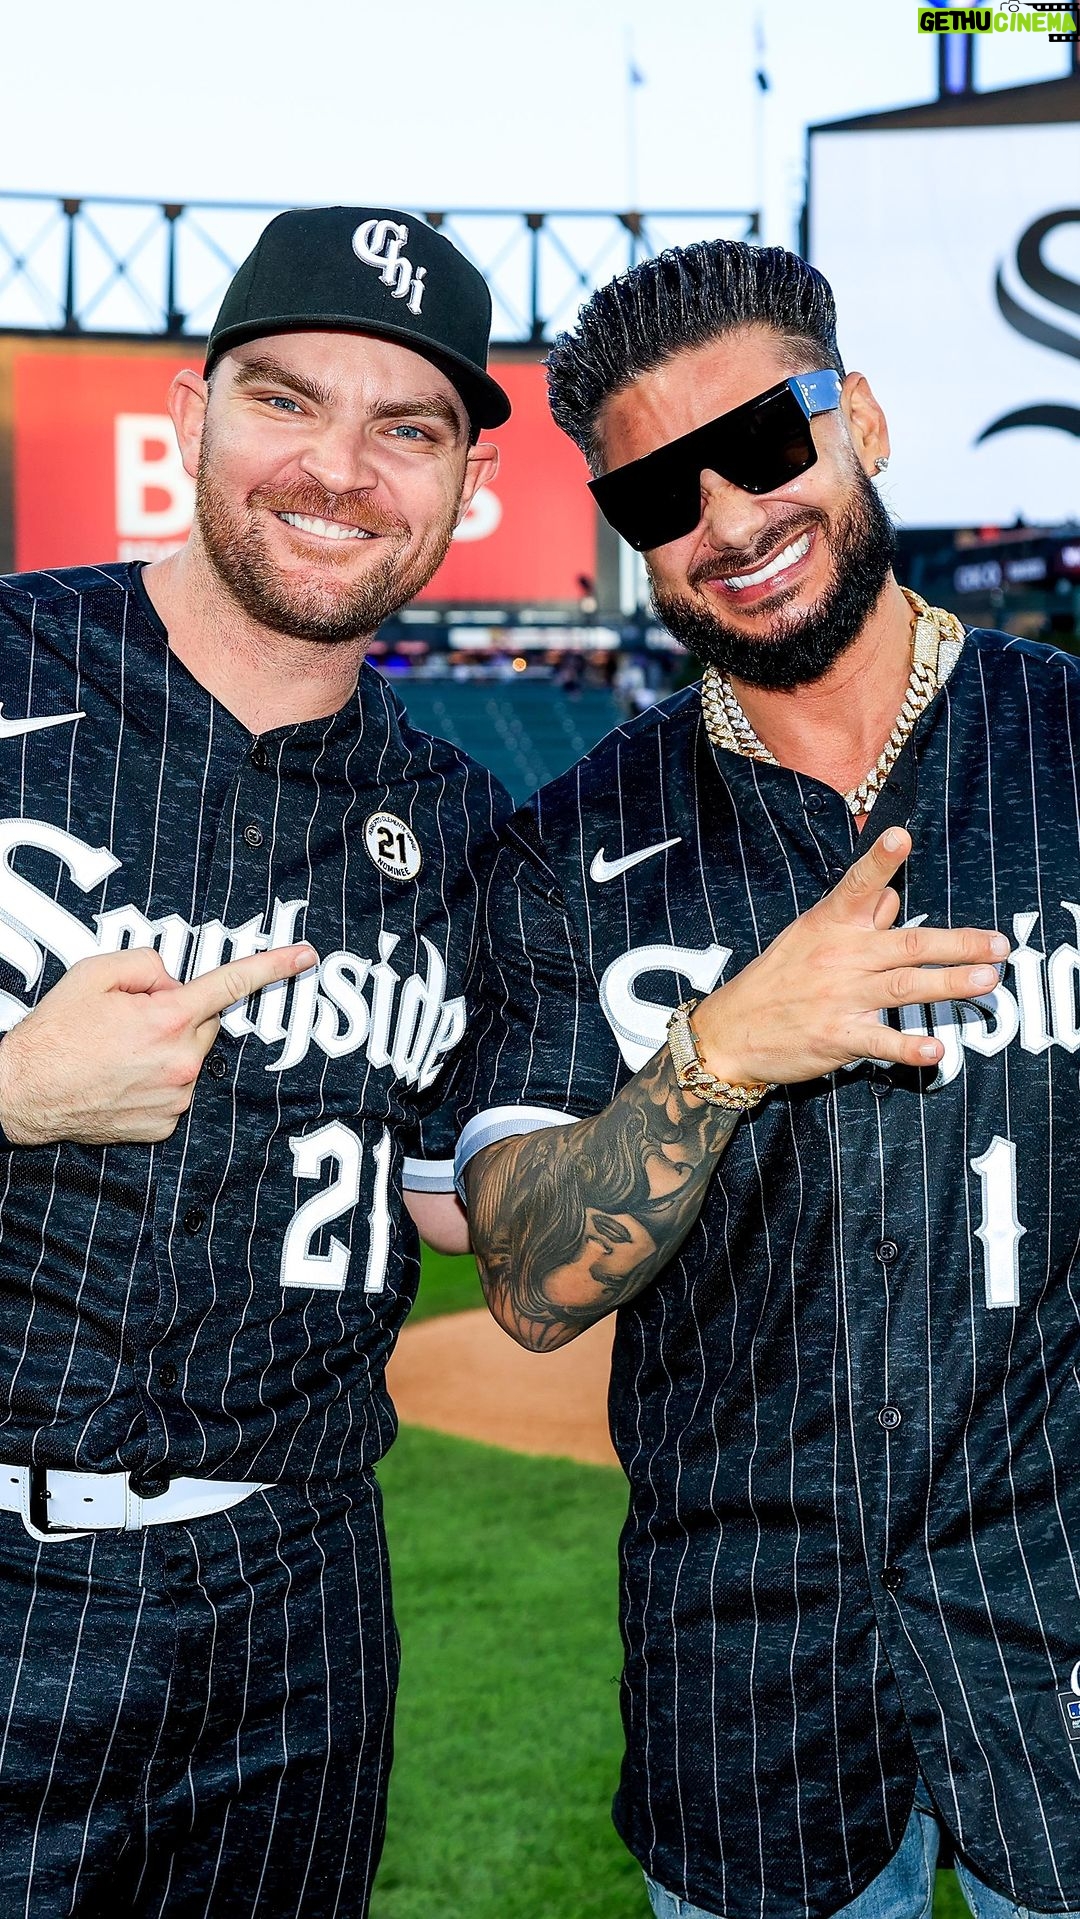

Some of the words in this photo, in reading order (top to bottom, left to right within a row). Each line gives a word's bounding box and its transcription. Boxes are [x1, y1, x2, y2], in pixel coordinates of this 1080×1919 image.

[351, 219, 428, 315] Chi
[377, 826, 407, 864] 21
[378, 857, 411, 877] NOMINEE
[280, 1119, 391, 1294] 21
[969, 1135, 1028, 1310] 1
